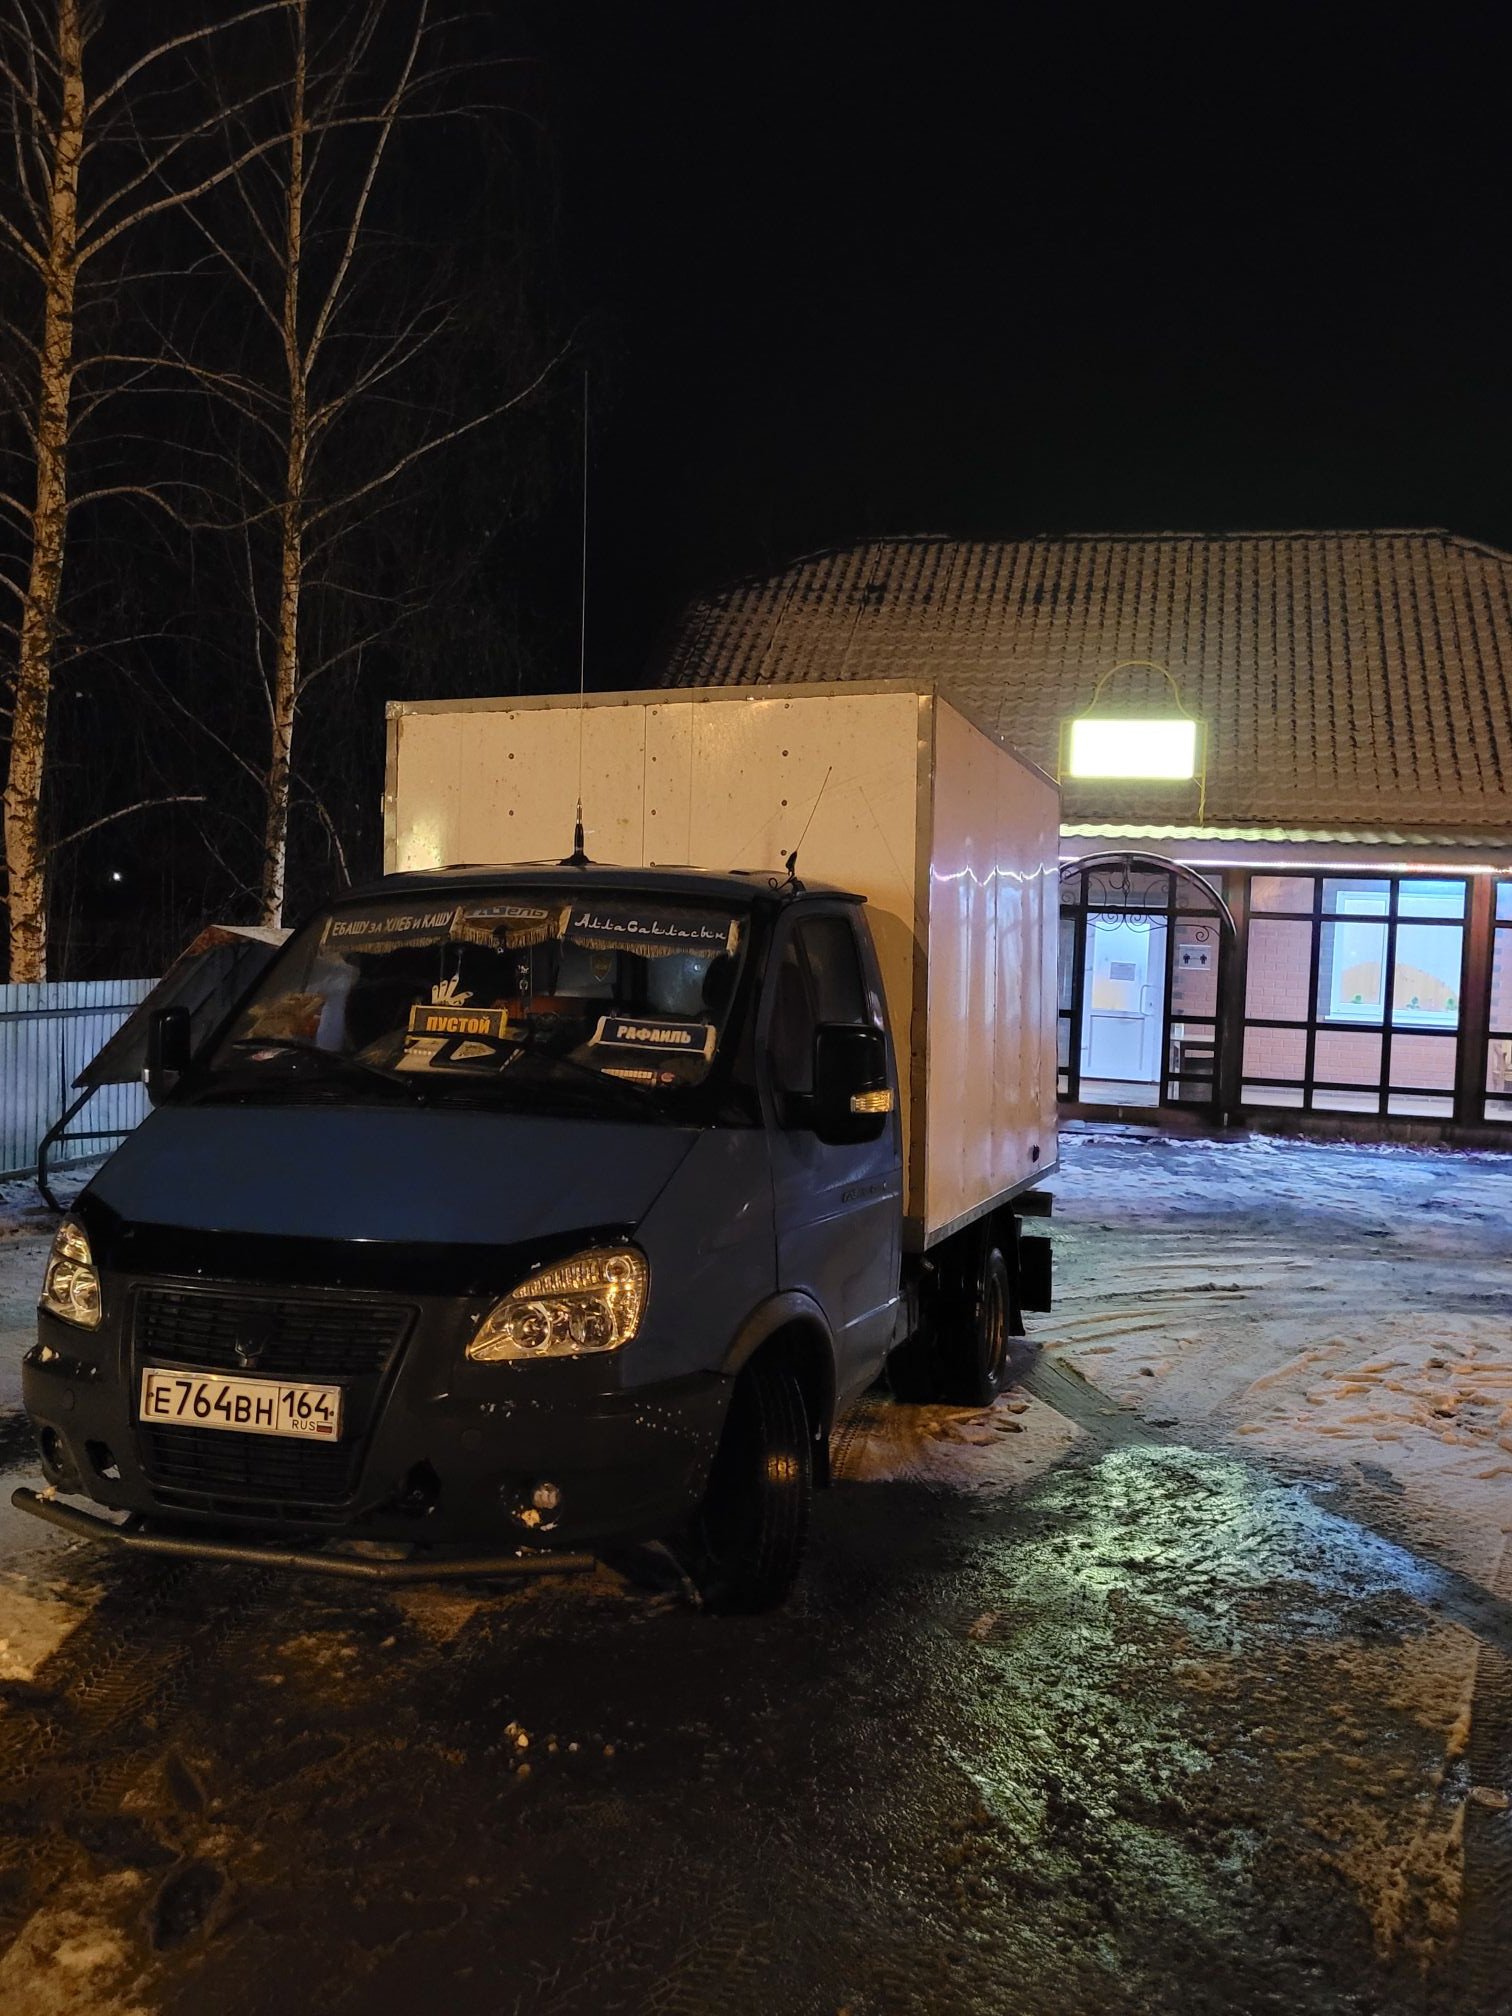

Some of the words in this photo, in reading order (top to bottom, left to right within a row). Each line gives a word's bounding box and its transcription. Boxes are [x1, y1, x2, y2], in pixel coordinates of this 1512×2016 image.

[332, 921, 370, 937] ЕБАШУ
[386, 916, 413, 932] ХЛЕБ
[422, 912, 453, 929] КАШУ
[426, 1016, 492, 1034] ПУСТОЙ
[616, 1025, 692, 1044] РАФАИЛЬ
[154, 1381, 273, 1426] Е764ВН
[281, 1390, 329, 1421] 164
[291, 1419, 316, 1432] RUS
